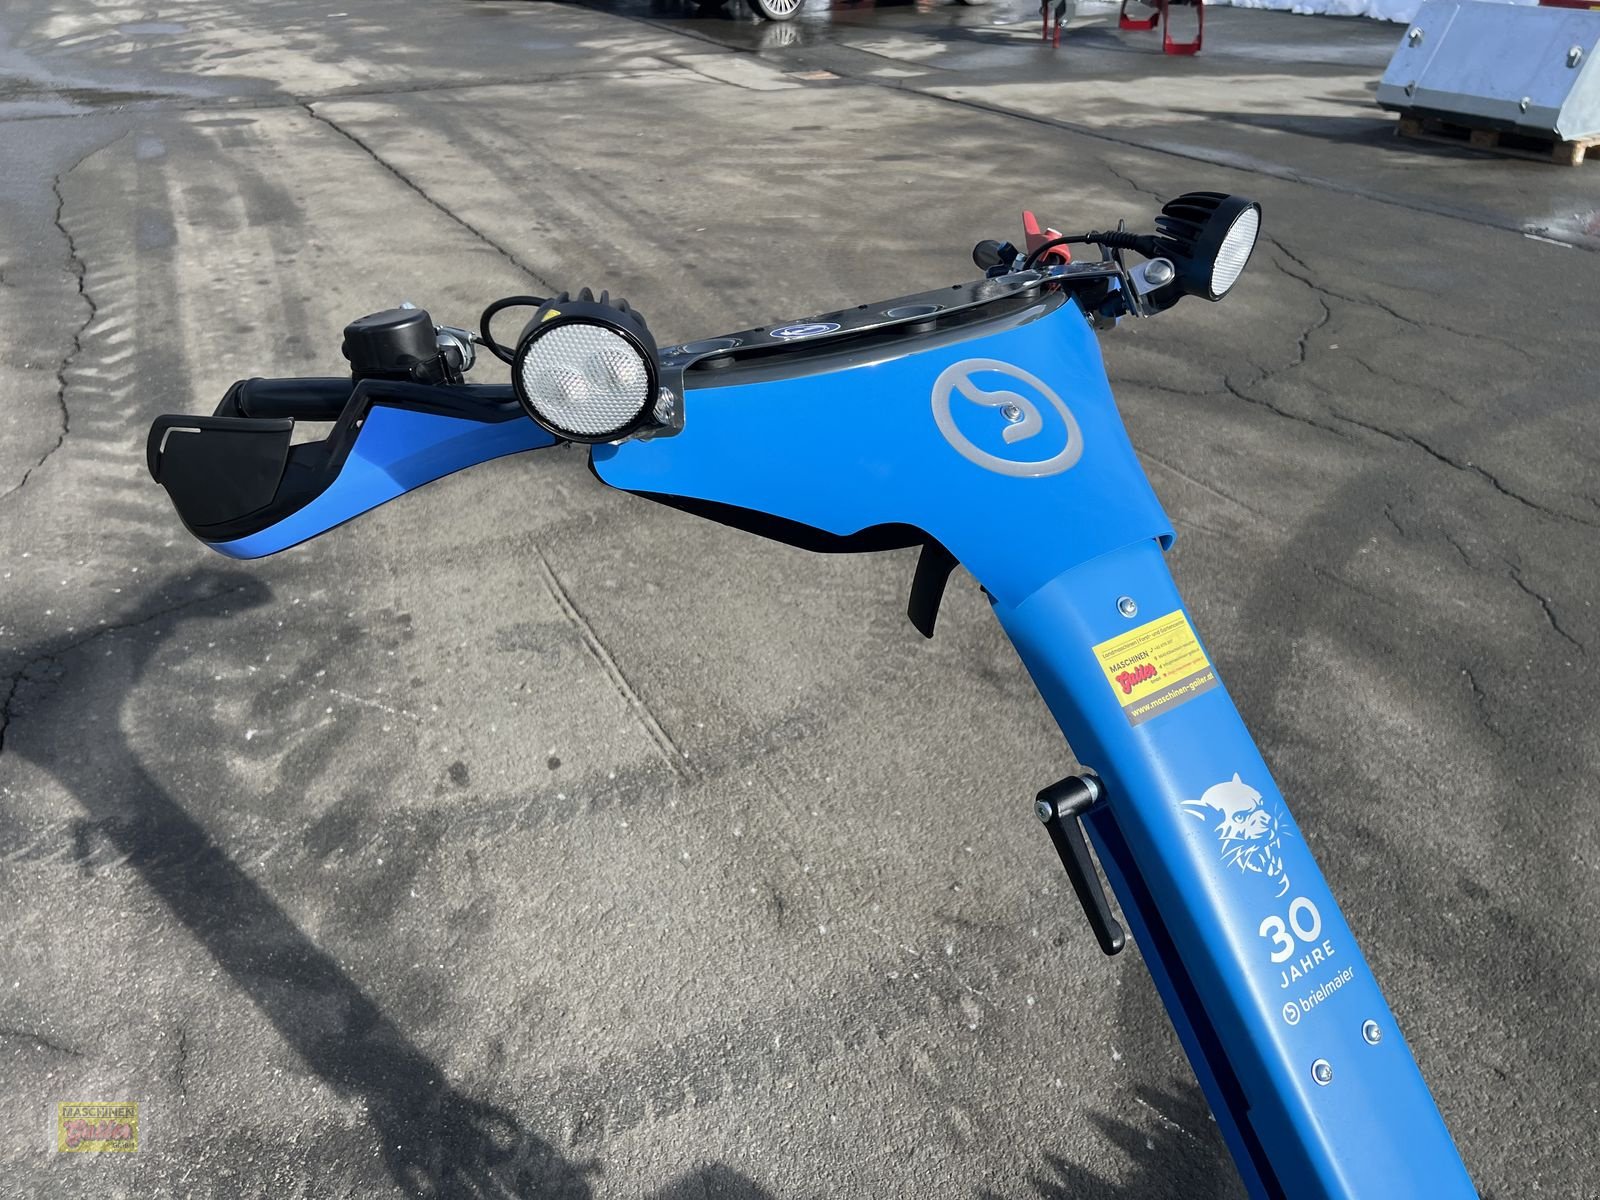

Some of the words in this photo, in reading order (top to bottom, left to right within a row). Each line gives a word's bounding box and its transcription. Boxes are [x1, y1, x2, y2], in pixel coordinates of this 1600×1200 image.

[1109, 650, 1149, 673] MASCHINEN
[1131, 672, 1214, 717] www.maschinen-gailer.at
[1259, 896, 1322, 964] 30
[1280, 939, 1336, 989] JAHRE
[1299, 966, 1355, 1012] brielmaier
